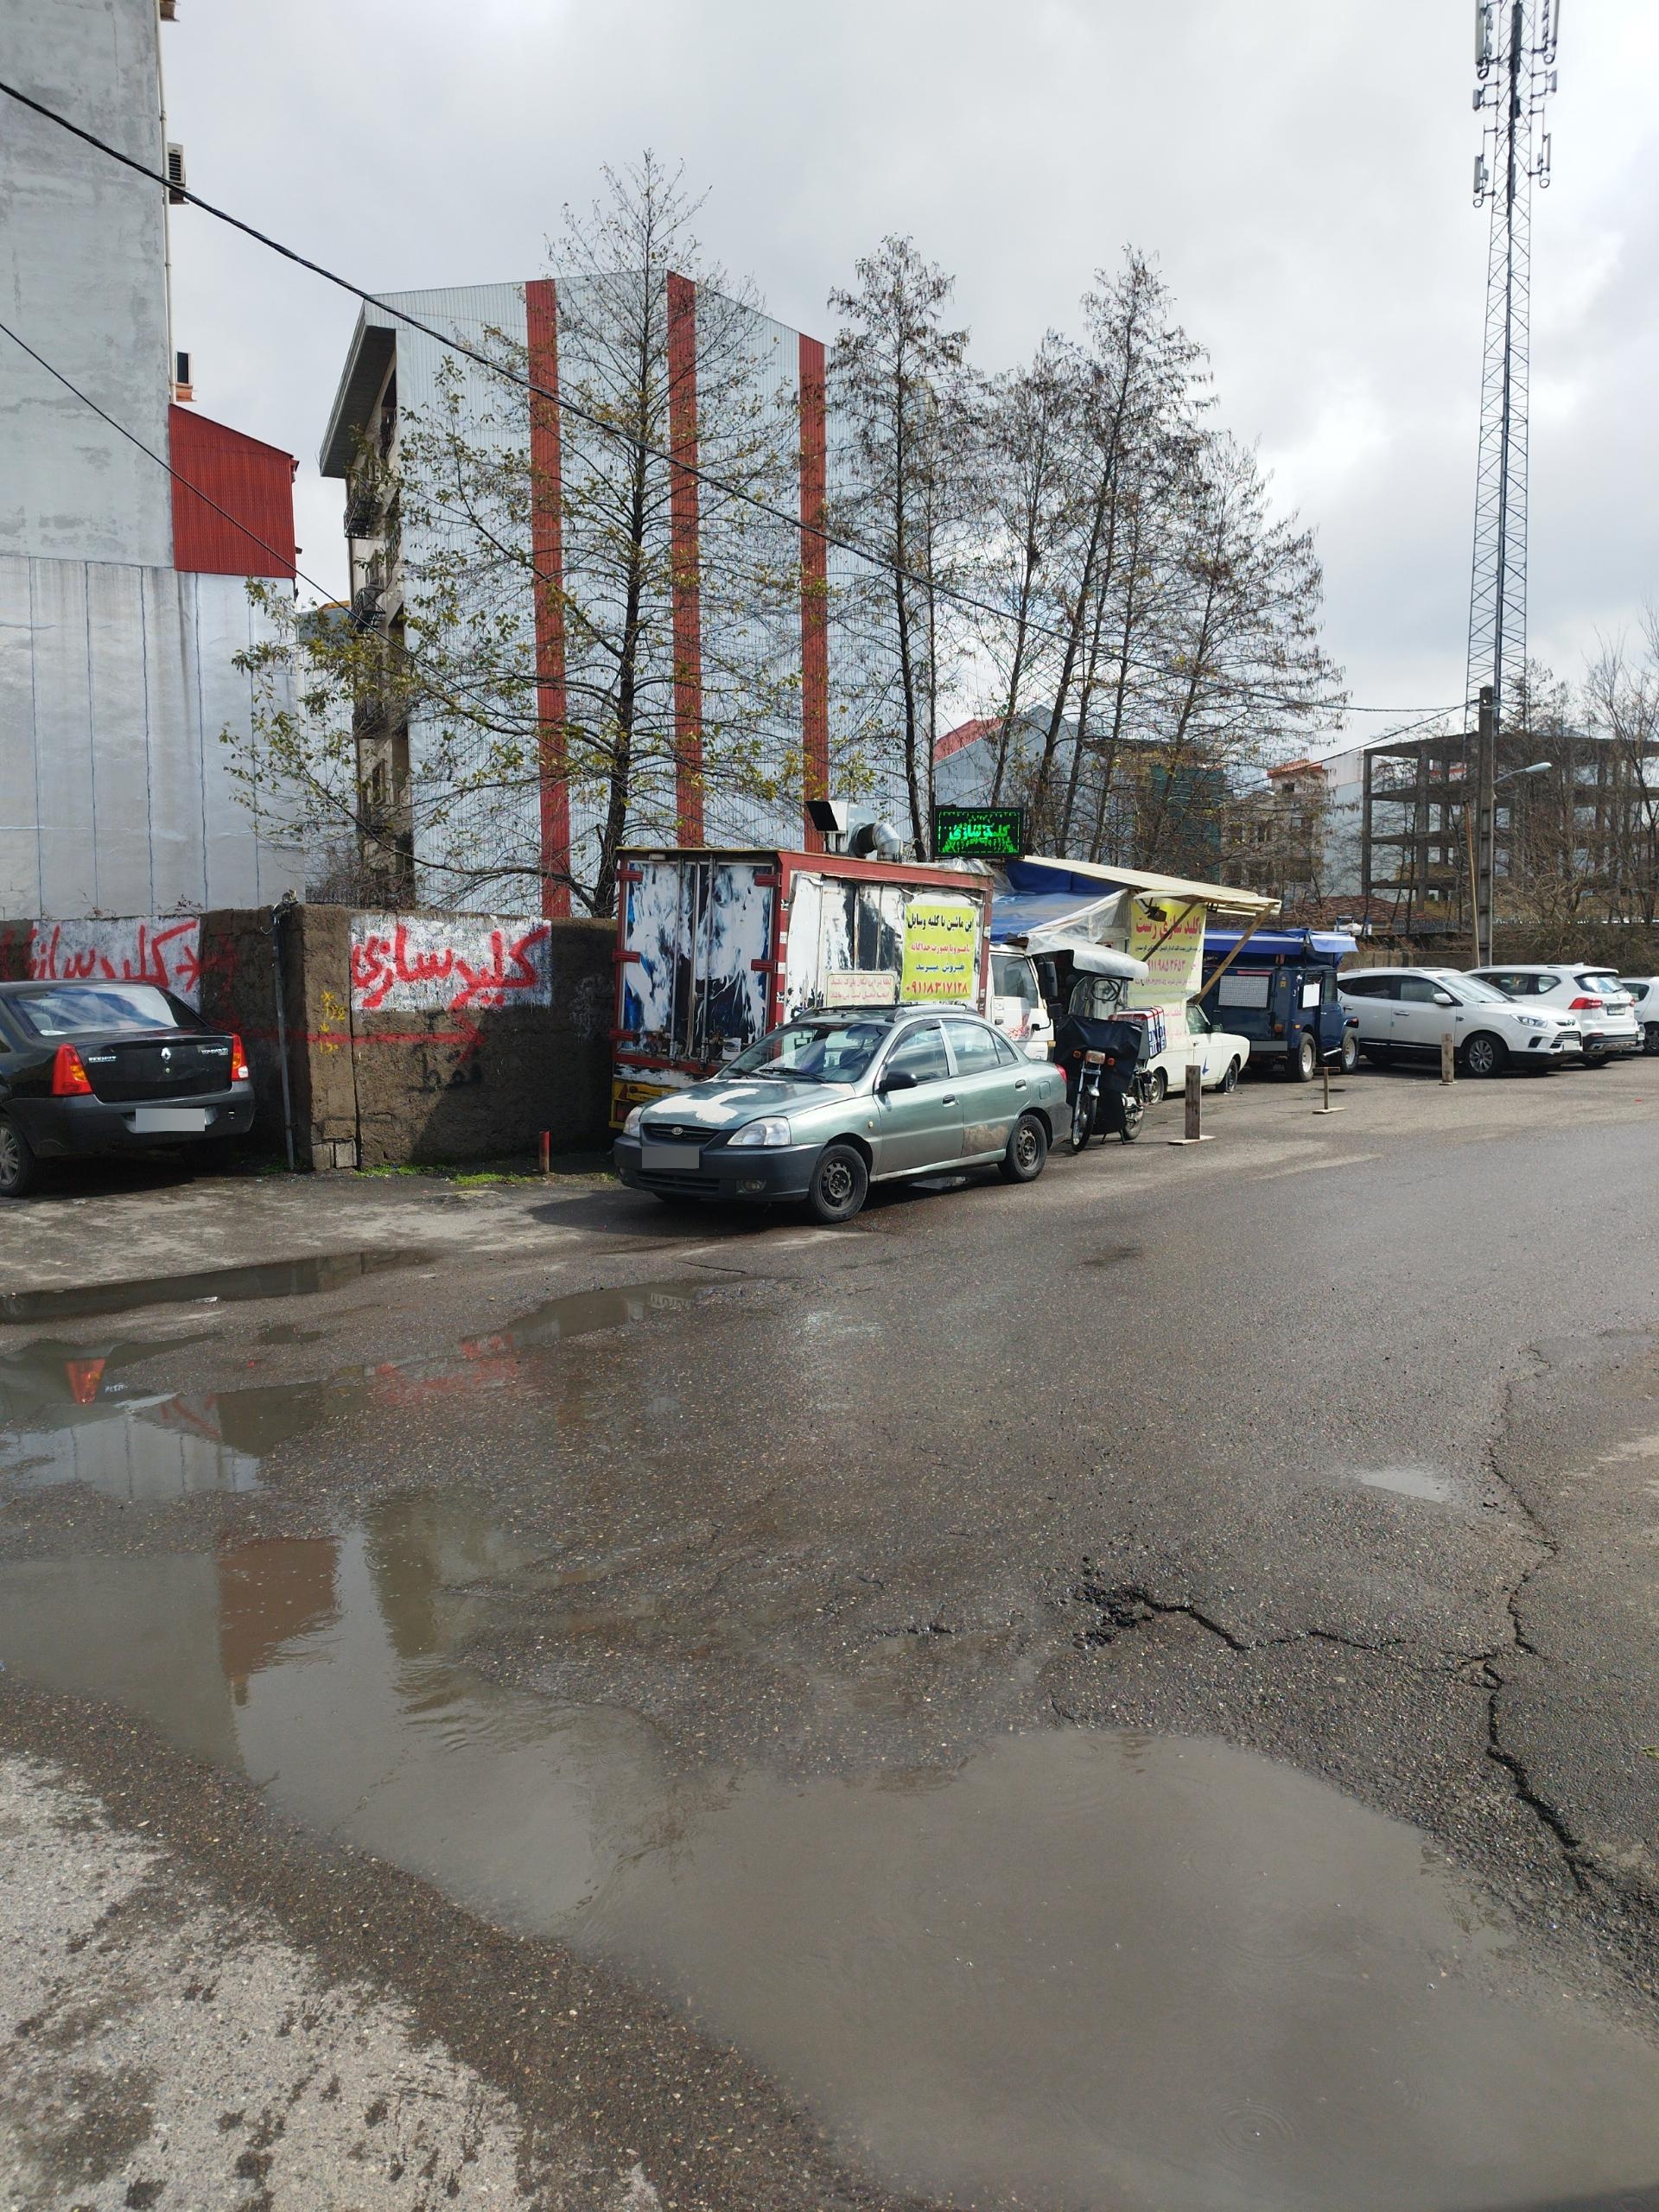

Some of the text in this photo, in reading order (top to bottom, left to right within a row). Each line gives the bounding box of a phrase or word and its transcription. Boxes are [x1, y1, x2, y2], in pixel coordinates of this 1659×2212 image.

[907, 912, 926, 931] وسایل
[928, 913, 940, 930] کلیه
[946, 916, 963, 931] ماشین
[965, 917, 974, 932] این
[351, 923, 550, 1010] کلید سازی
